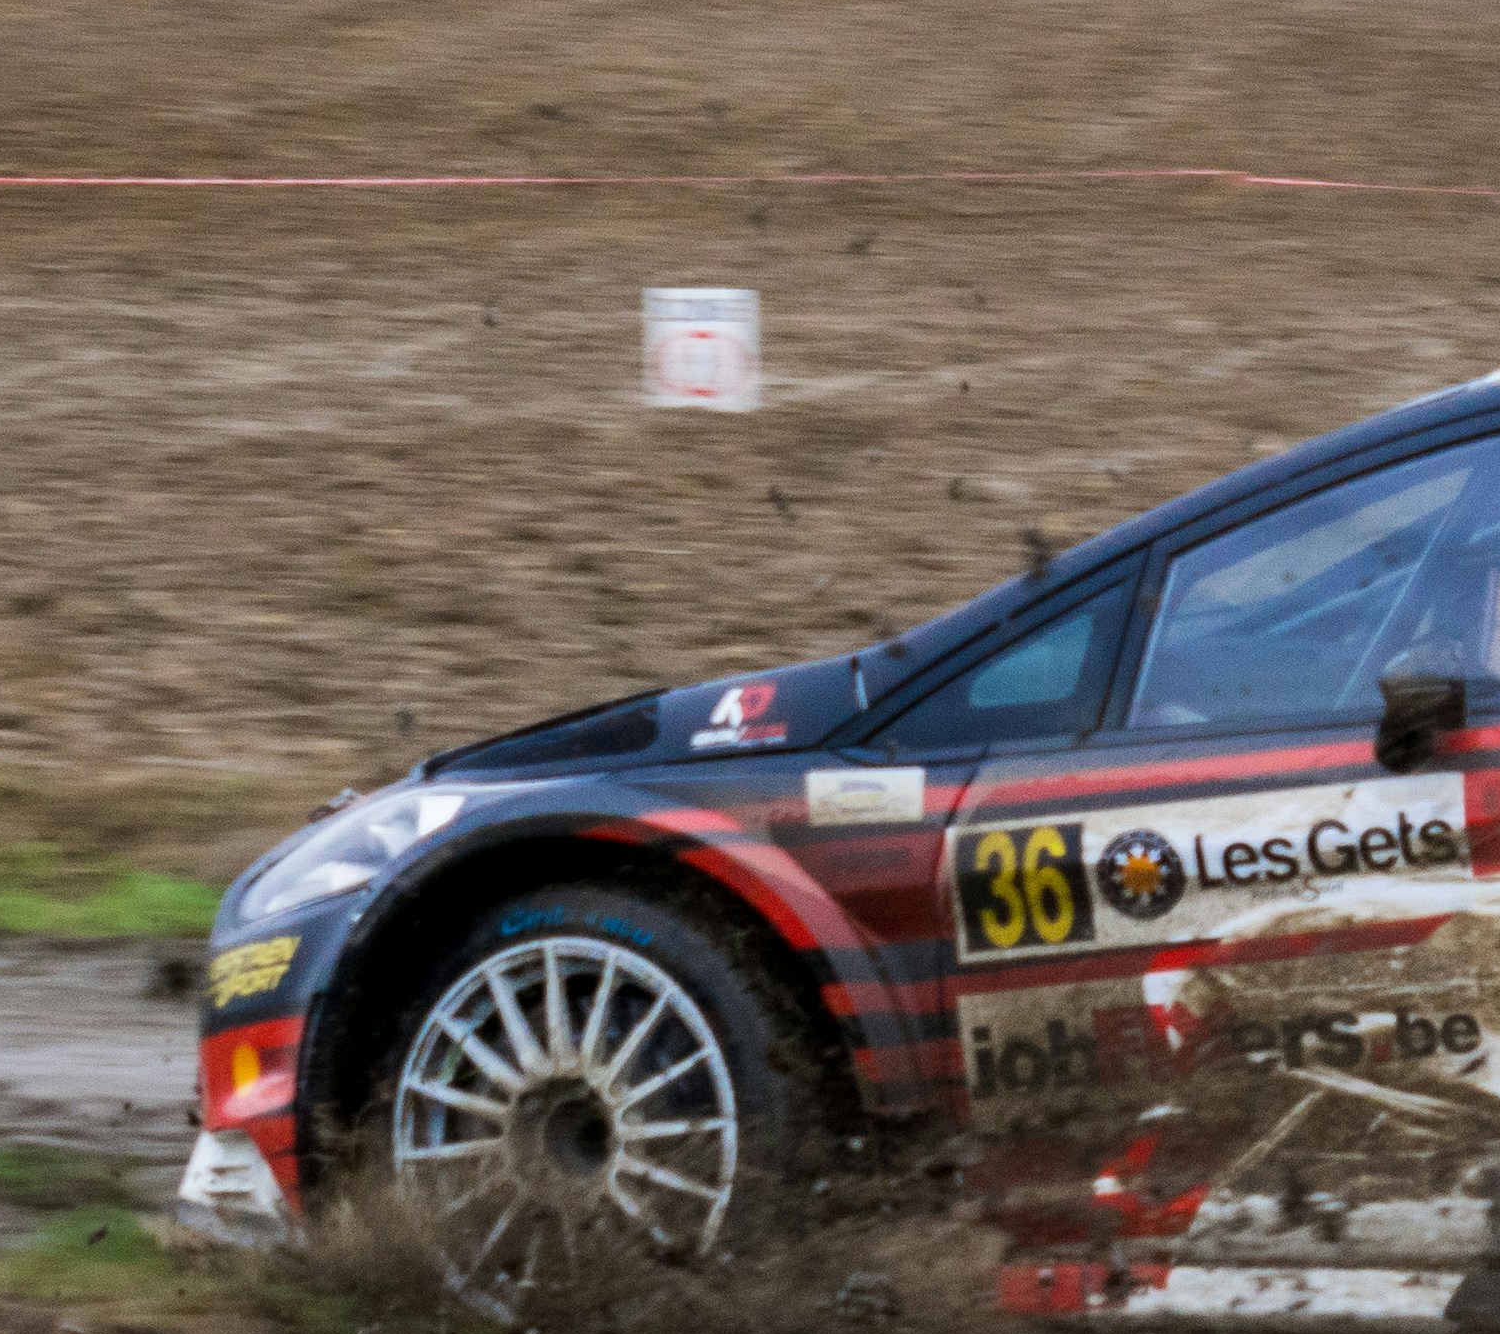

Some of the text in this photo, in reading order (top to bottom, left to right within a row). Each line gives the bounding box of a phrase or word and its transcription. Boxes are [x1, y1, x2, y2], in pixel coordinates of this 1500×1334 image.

[975, 825, 1076, 949] 36
[1194, 810, 1459, 889] Les Gets
